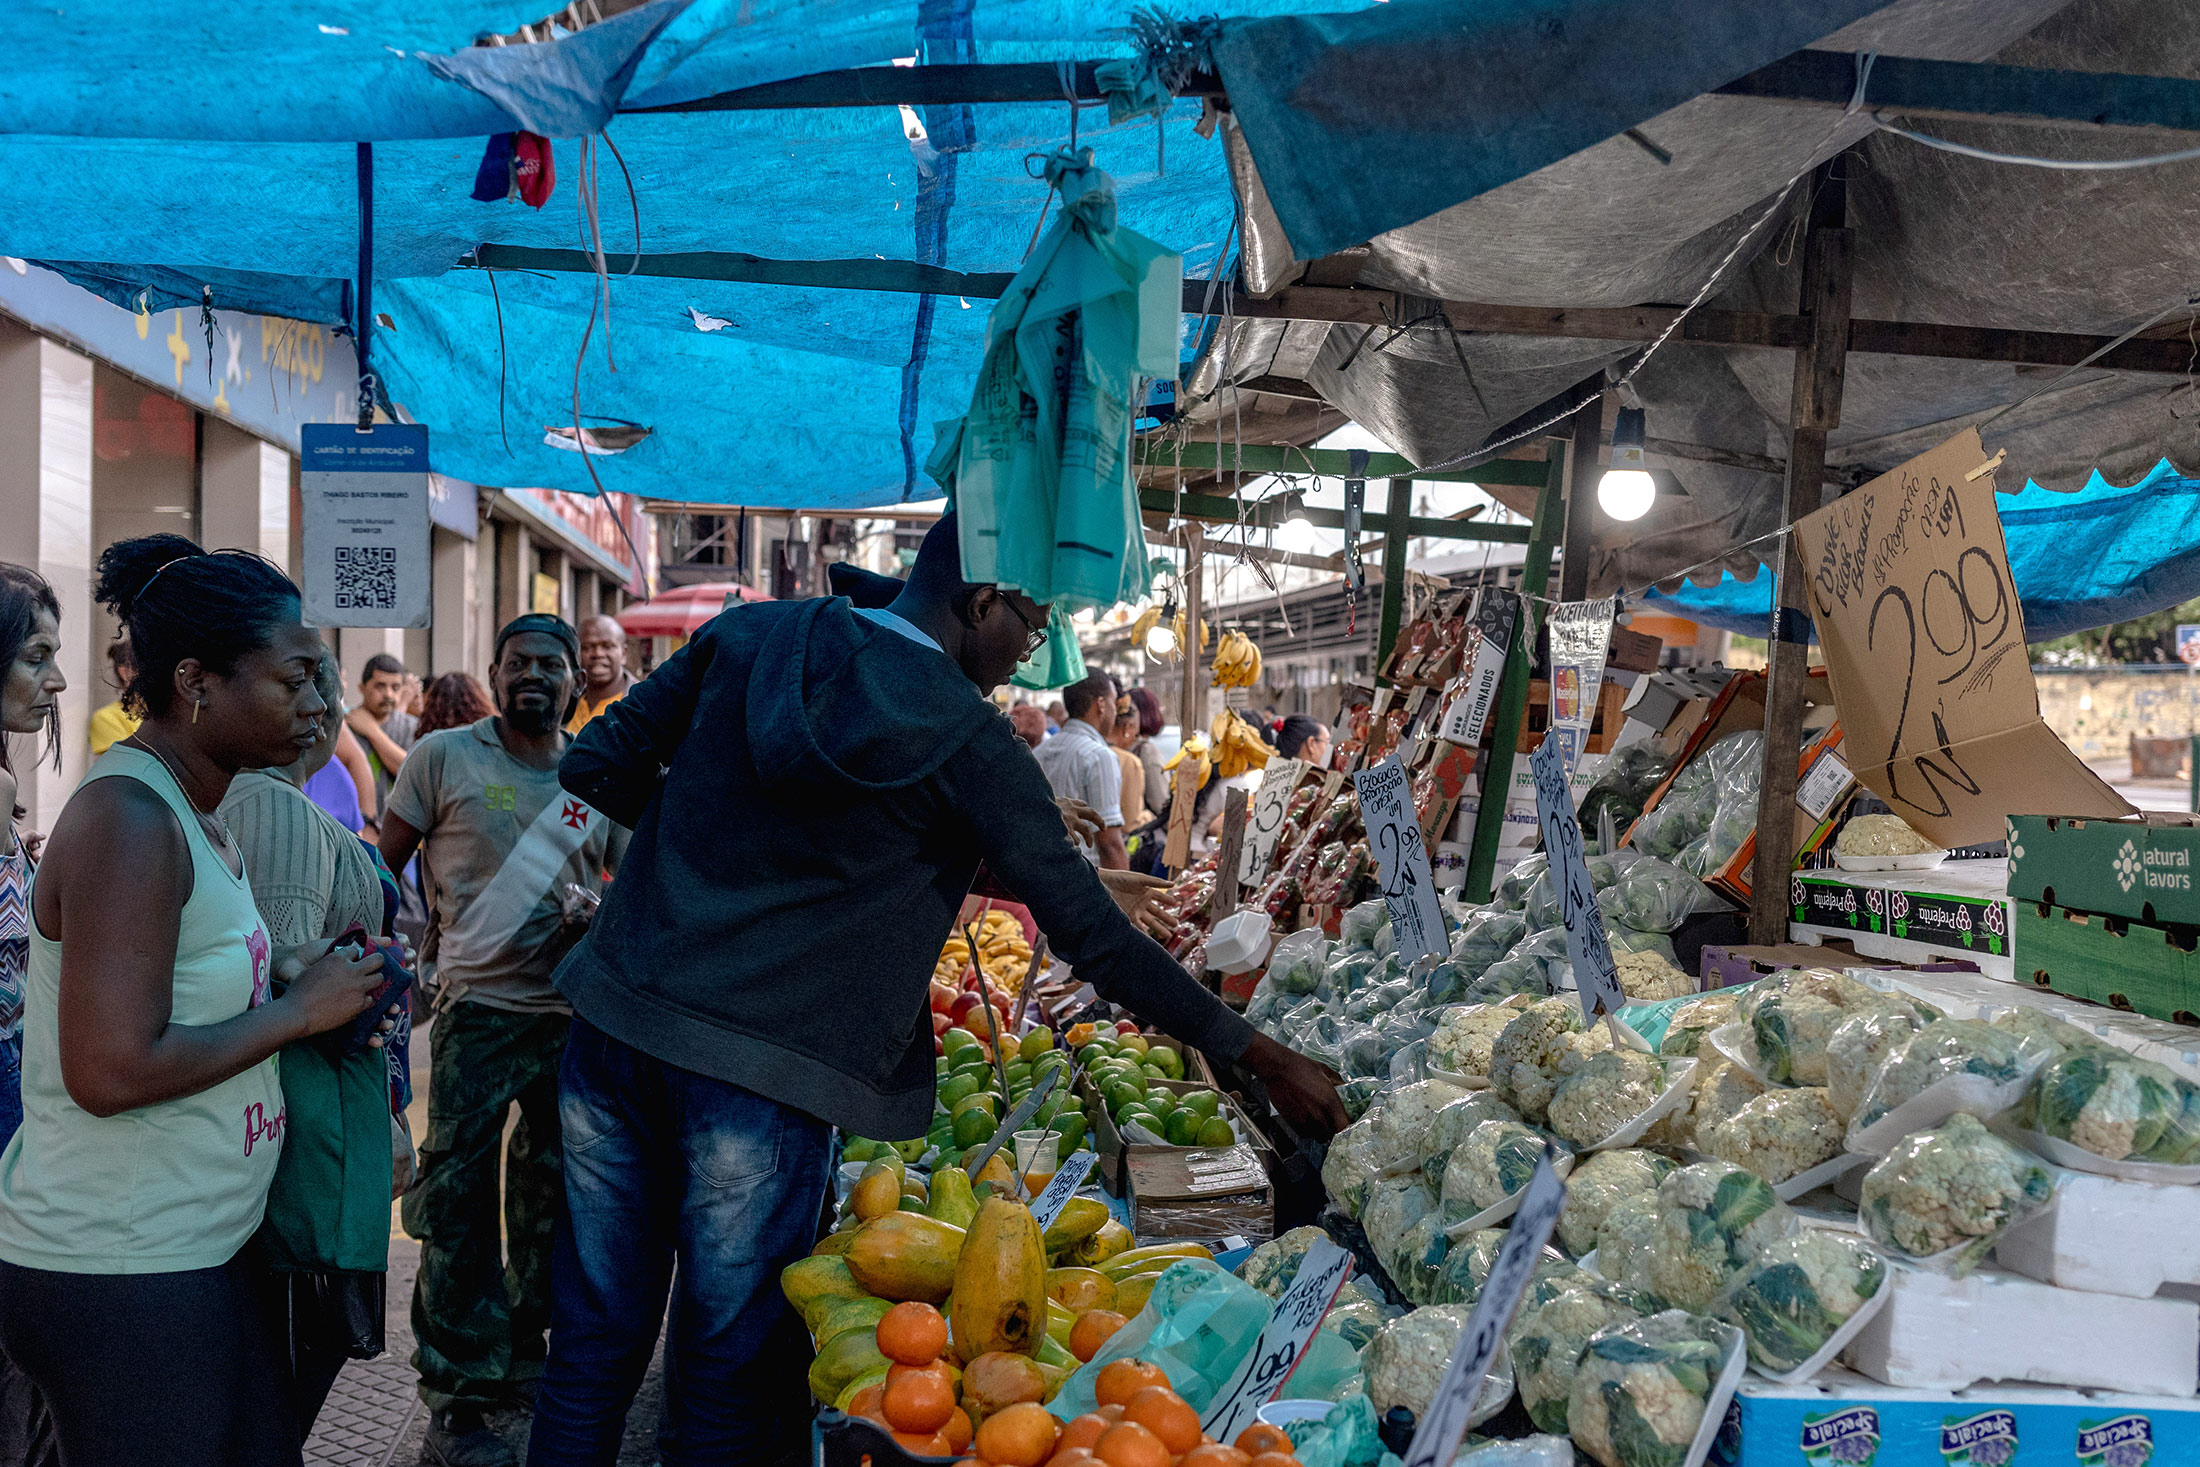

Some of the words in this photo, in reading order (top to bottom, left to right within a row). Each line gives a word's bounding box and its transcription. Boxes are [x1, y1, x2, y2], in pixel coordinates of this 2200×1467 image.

[314, 445, 344, 454] CARTÃO
[1553, 600, 1614, 623] ACEITAMOS
[1467, 669, 1495, 740] SELECIONADOS
[485, 784, 516, 811] 98
[2144, 869, 2191, 889] lavors
[1810, 1412, 1874, 1440] Speciale
[1949, 1414, 2012, 1444] Speciale
[2084, 1418, 2148, 1448] Speciale
